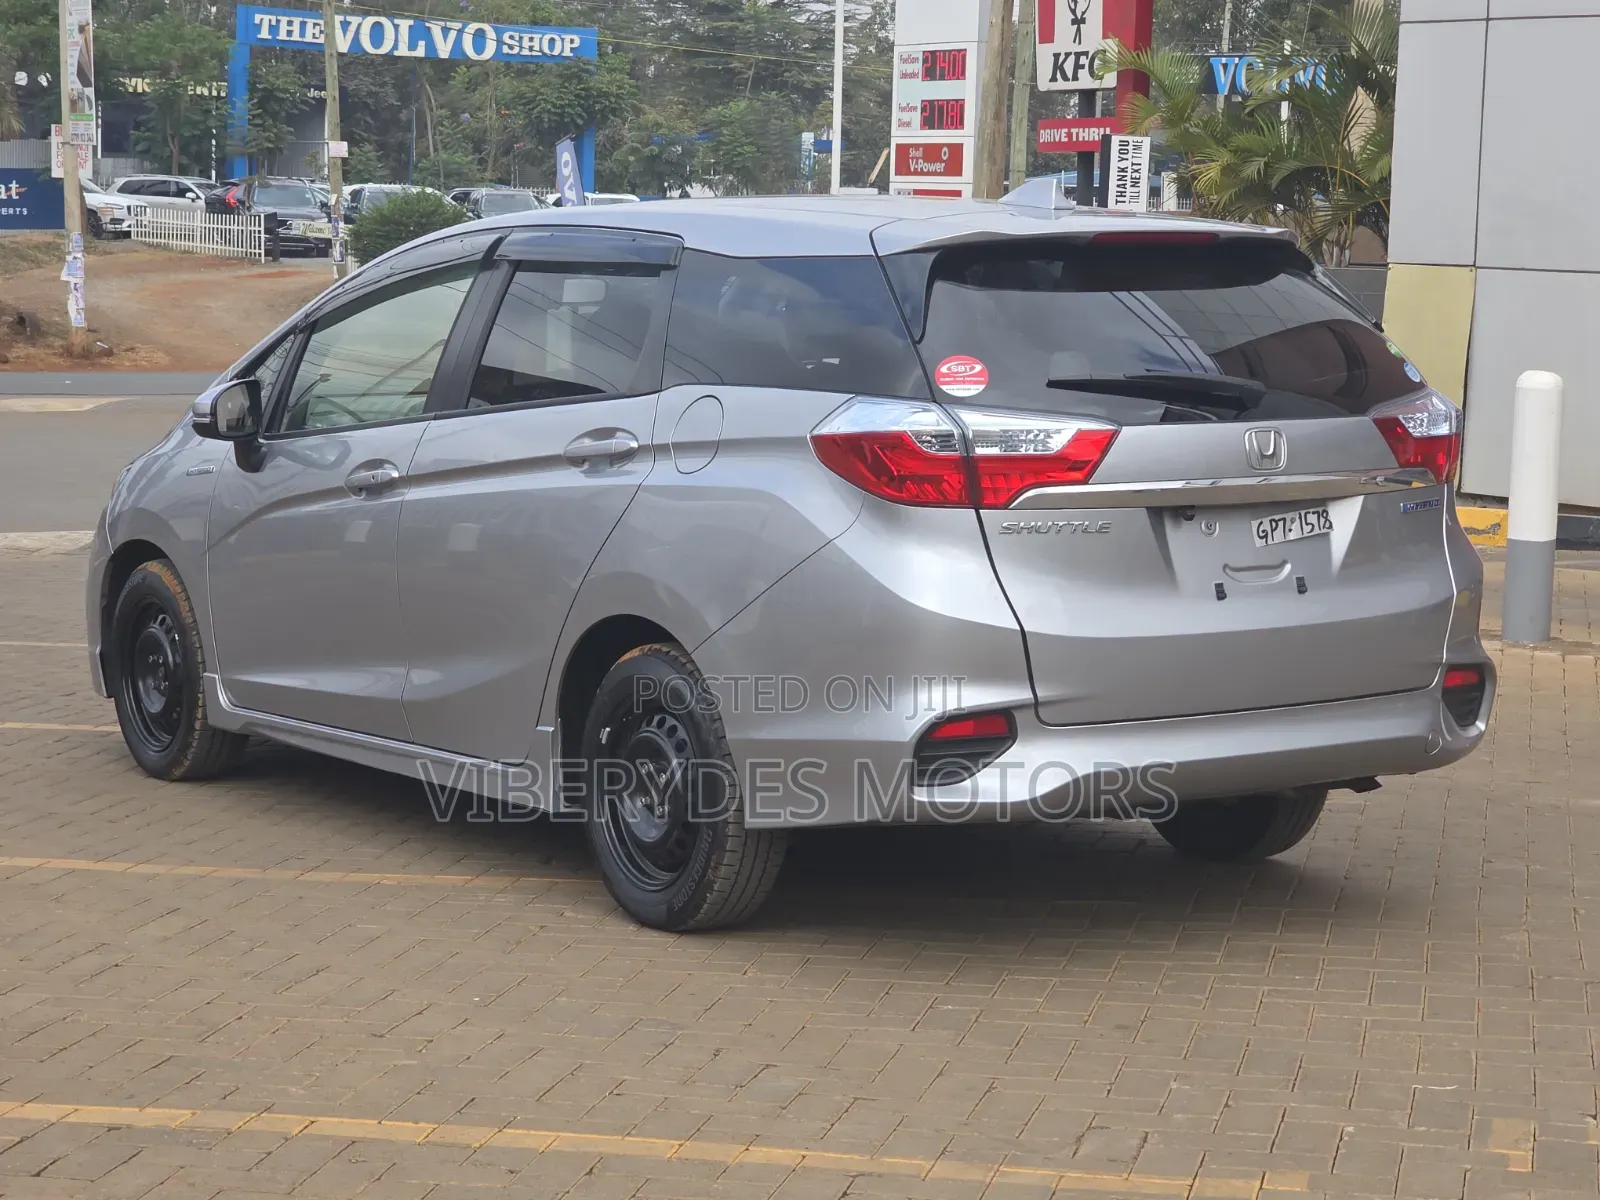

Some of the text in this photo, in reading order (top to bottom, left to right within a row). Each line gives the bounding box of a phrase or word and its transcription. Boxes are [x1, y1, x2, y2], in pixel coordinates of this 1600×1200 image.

[254, 14, 580, 61] THE VOLVO SHOP
[900, 54, 919, 65] FuelSave
[1049, 49, 1106, 83] KFC
[900, 69, 919, 80] Unleaded
[307, 88, 327, 99] Jee
[898, 103, 918, 113] FuelSave
[898, 118, 912, 128] Diesel
[1039, 128, 1069, 143] DRIVE
[909, 147, 923, 159] Shell
[909, 159, 946, 173] V-Power
[1115, 139, 1130, 205] THANK YOU
[1129, 139, 1144, 204] TILL NEXT TIME
[950, 365, 971, 373] SBT
[998, 520, 1112, 535] SHUTTLE
